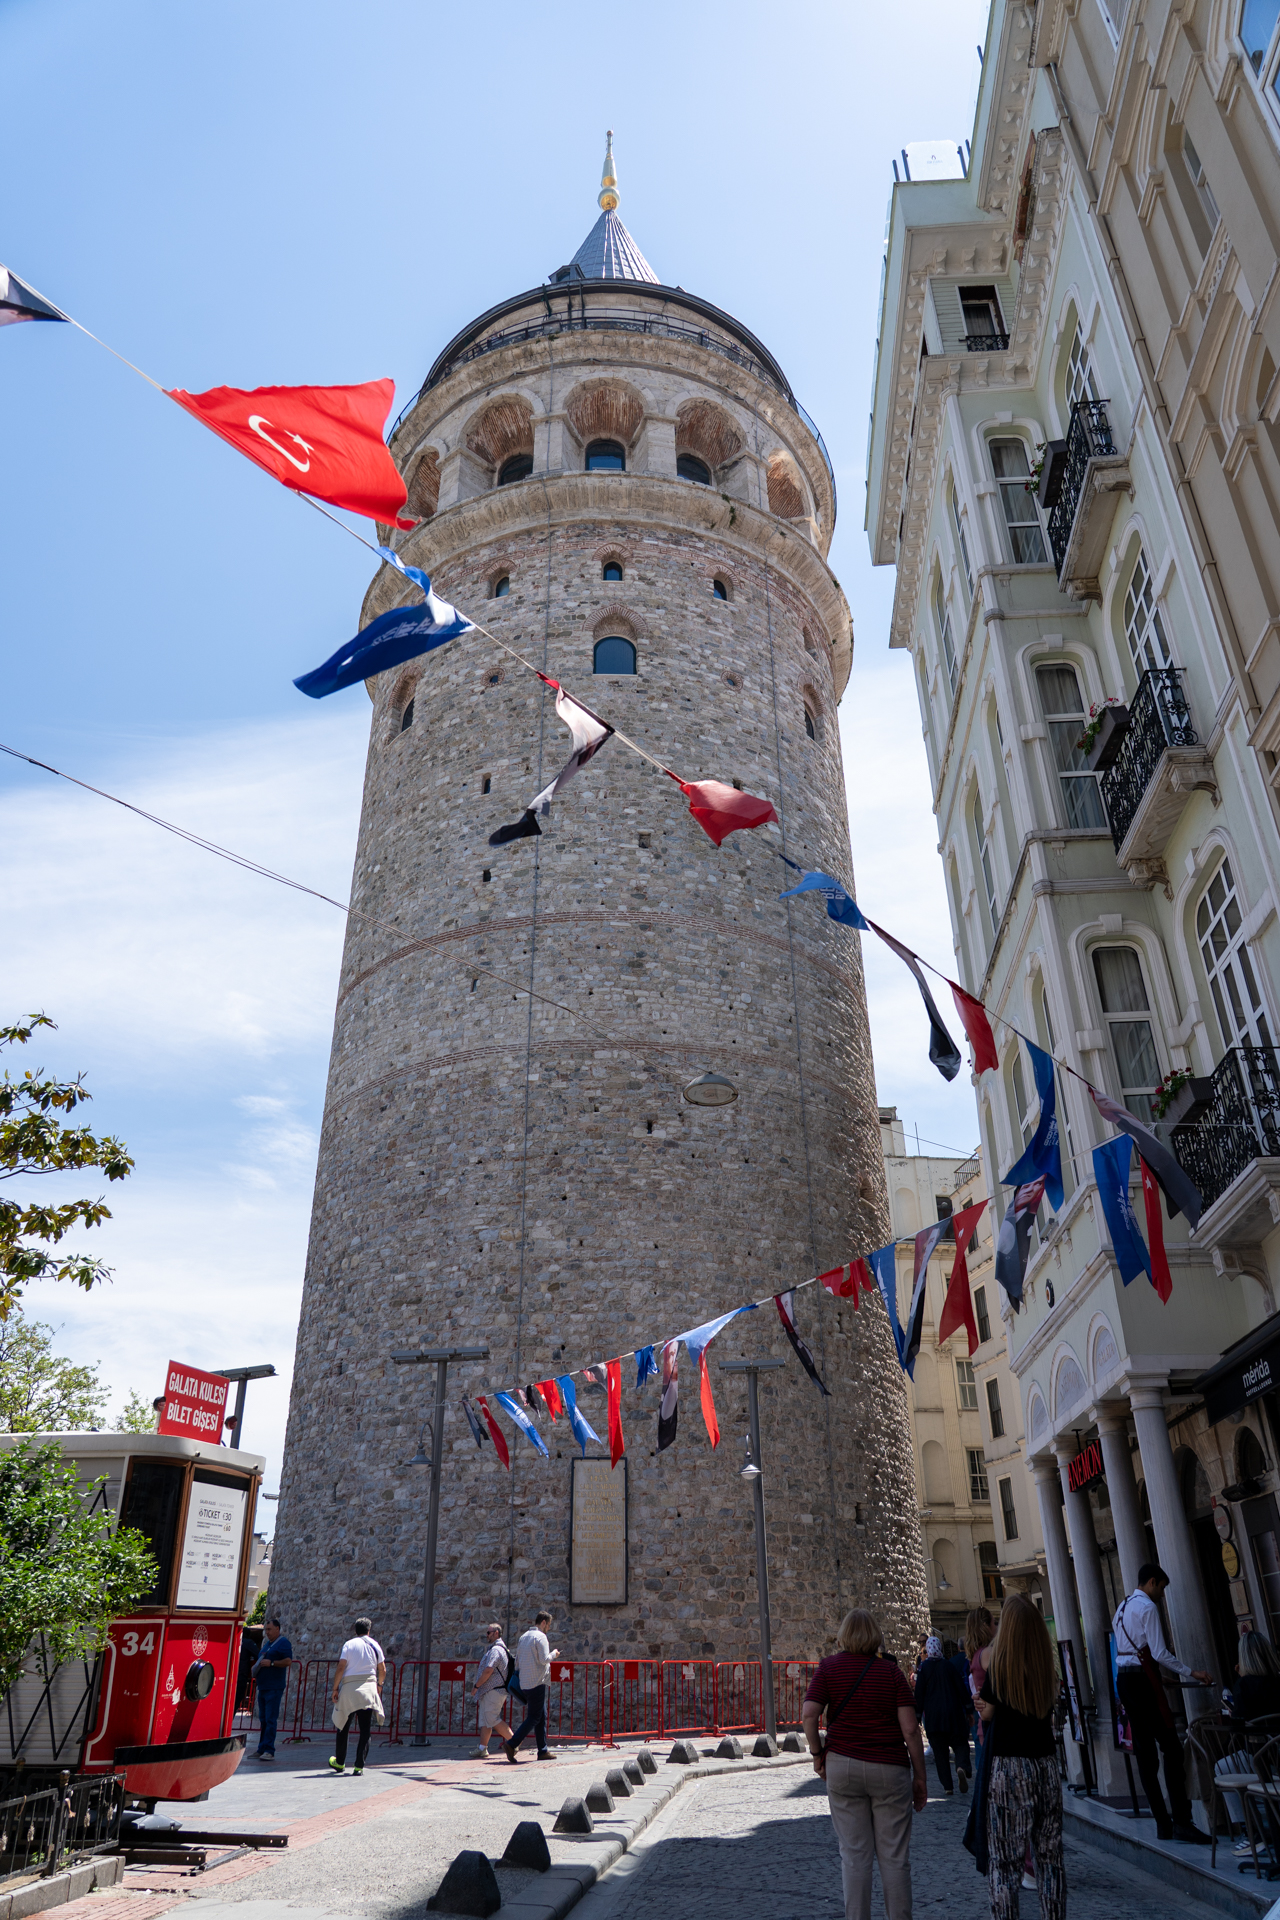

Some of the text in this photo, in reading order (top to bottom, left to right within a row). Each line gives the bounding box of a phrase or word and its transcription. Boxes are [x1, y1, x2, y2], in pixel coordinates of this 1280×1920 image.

[1242, 1358, 1271, 1388] mérida
[168, 1372, 227, 1406] GALATA KULESİ
[166, 1399, 220, 1432] BİLET GİŞESİ
[1068, 1439, 1102, 1492] ANEMON
[203, 1509, 221, 1520] TICKET
[121, 1631, 155, 1656] 34
